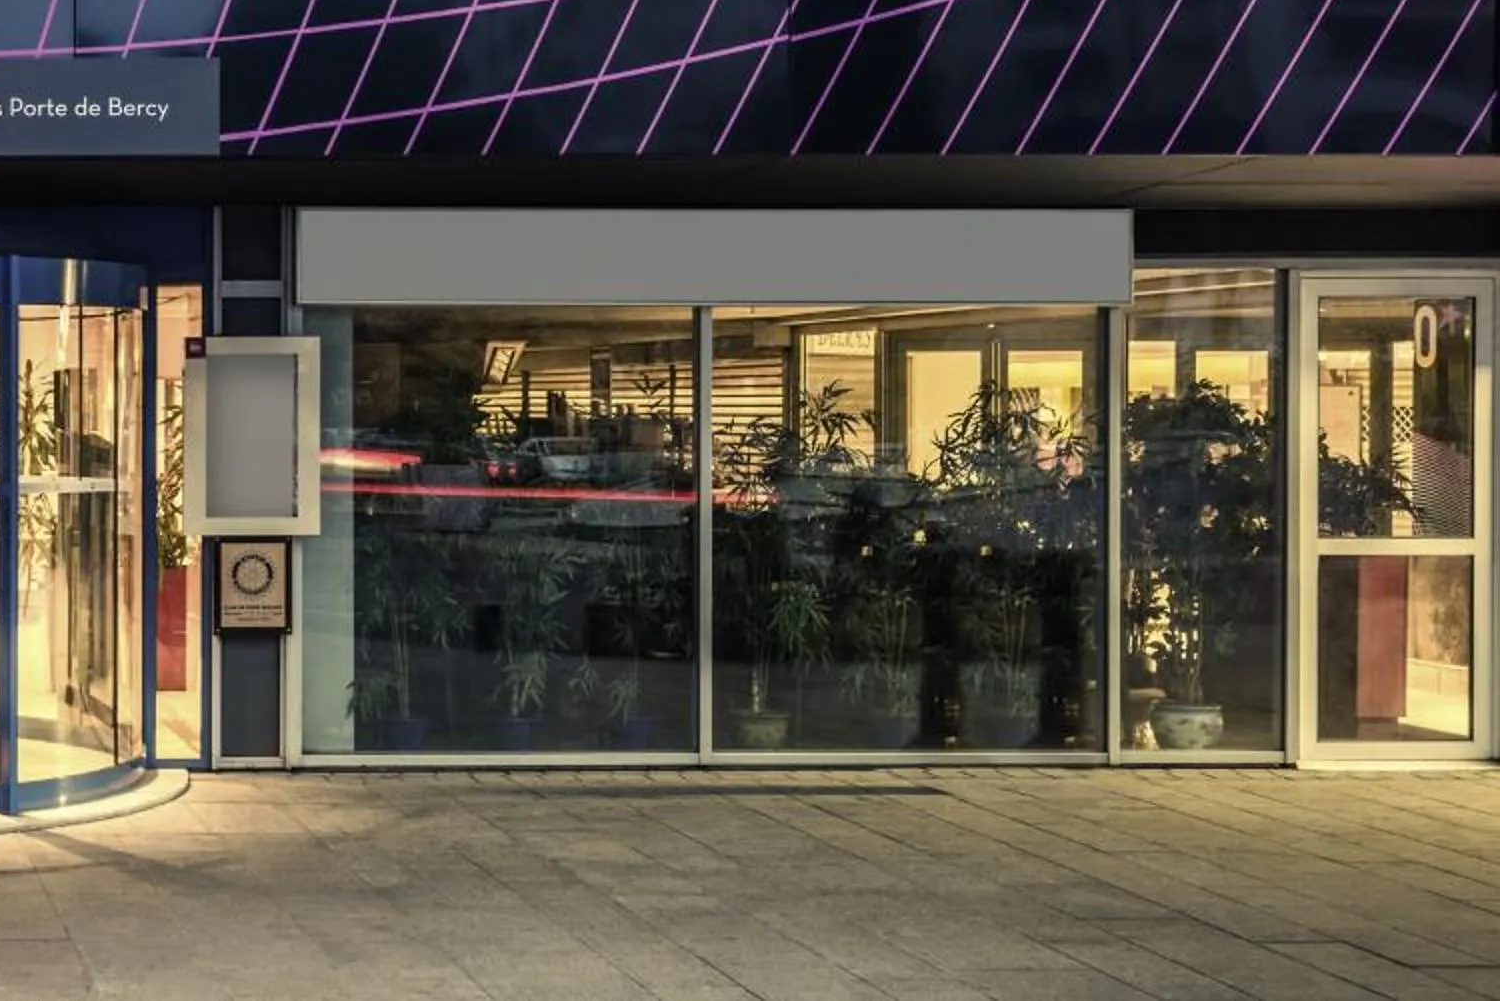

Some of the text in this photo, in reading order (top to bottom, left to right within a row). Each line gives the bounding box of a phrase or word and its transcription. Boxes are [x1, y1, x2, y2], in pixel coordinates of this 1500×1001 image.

[10, 97, 68, 116] Porte
[74, 96, 101, 116] de
[108, 96, 169, 122] Bercy
